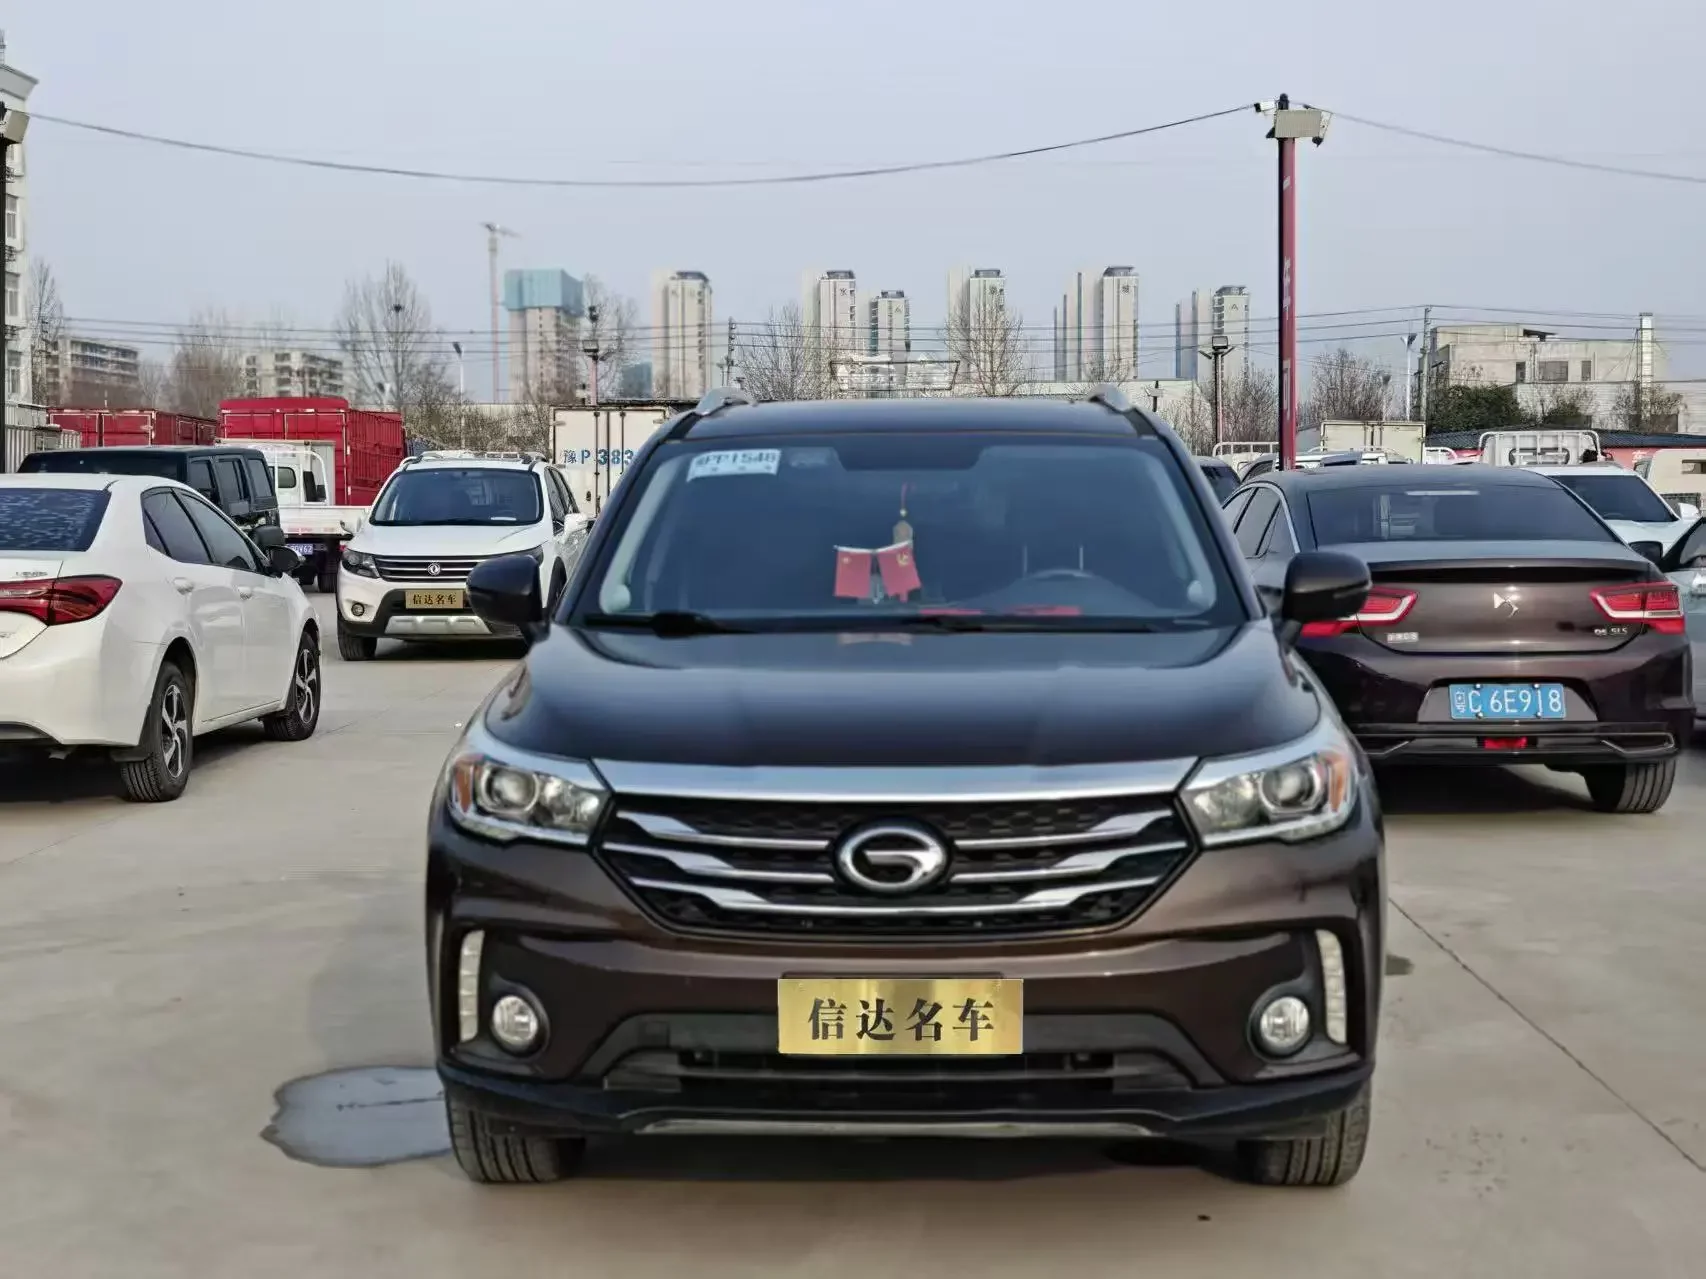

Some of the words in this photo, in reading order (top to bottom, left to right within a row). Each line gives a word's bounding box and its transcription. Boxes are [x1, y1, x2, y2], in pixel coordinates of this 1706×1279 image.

[412, 594, 457, 605] 信达名车
[807, 998, 994, 1041] 信达名车
